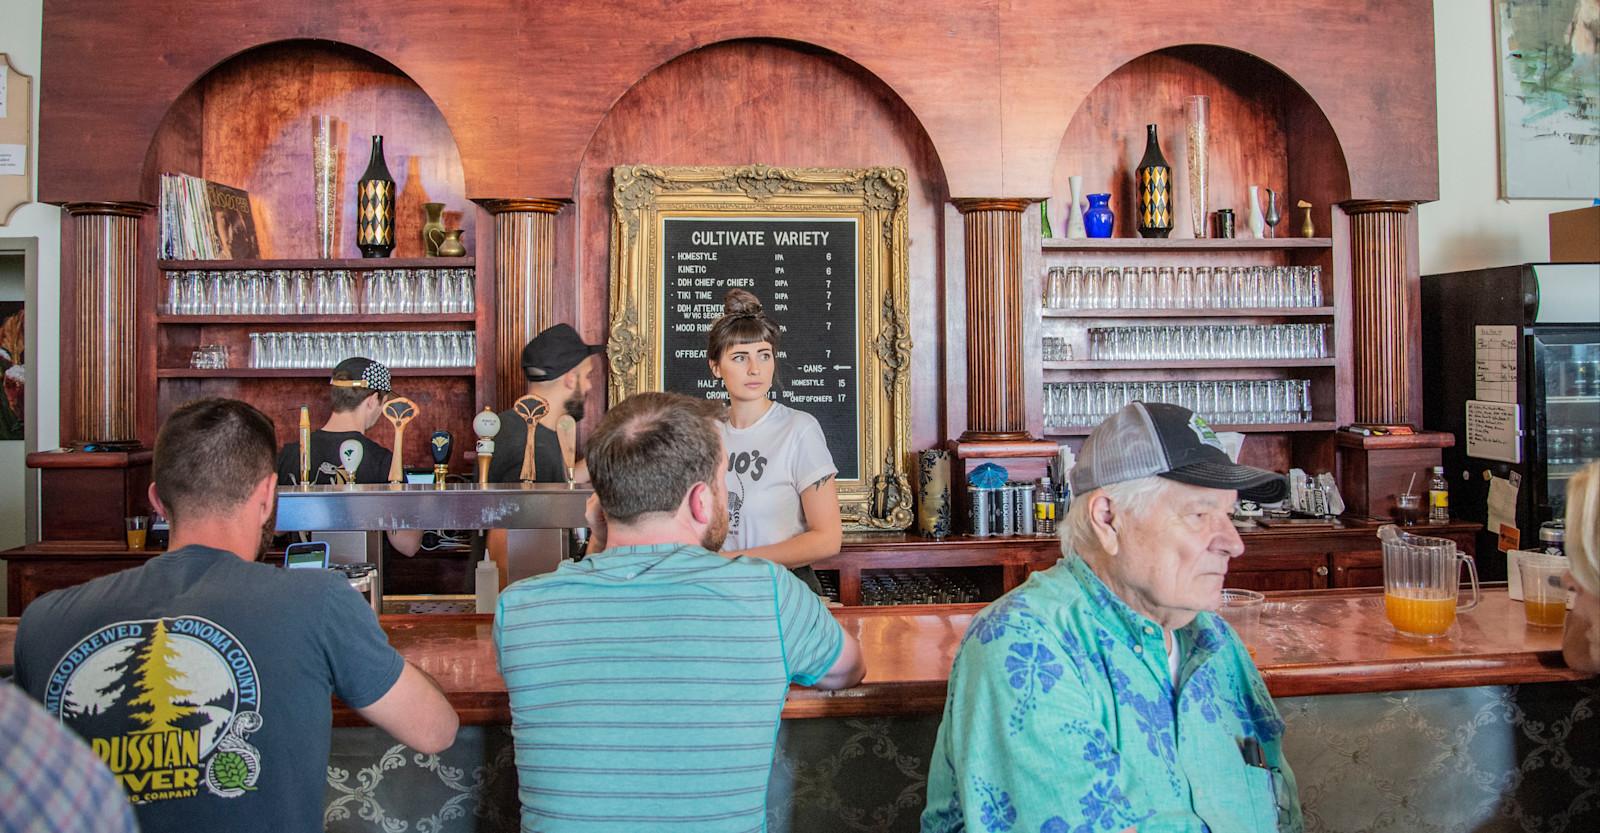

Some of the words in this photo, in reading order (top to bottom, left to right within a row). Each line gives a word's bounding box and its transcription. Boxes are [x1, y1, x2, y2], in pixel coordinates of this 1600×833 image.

[691, 231, 765, 246] CULTIVATE
[773, 231, 830, 246] VARIETY
[677, 252, 717, 261] HOMESTYLE
[826, 252, 832, 261] 6
[677, 265, 707, 274] KINETIC
[826, 267, 832, 275] 6
[677, 278, 692, 287] DDH
[694, 278, 715, 287] CHIEF
[726, 278, 755, 287] CHIEFS
[826, 280, 831, 288] 7
[677, 291, 691, 300] TIKI
[695, 291, 712, 300] TIME
[774, 292, 788, 300] DIPA
[826, 291, 832, 300] 7
[677, 304, 691, 313] DDH
[774, 303, 788, 311] DIPA
[826, 303, 832, 311] 7
[675, 324, 696, 332] MOOD
[826, 322, 832, 330] 7
[675, 350, 708, 358] OFFBEAT
[826, 350, 831, 359] 7
[697, 380, 718, 388] HALF
[791, 379, 825, 387] HOMESTYLE
[838, 379, 846, 388] 15
[838, 394, 846, 402] 17
[171, 618, 233, 653] SONOMA
[226, 647, 258, 706] COUNTY
[47, 624, 143, 715] MICROBREWED
[144, 788, 199, 801] COMPANY
